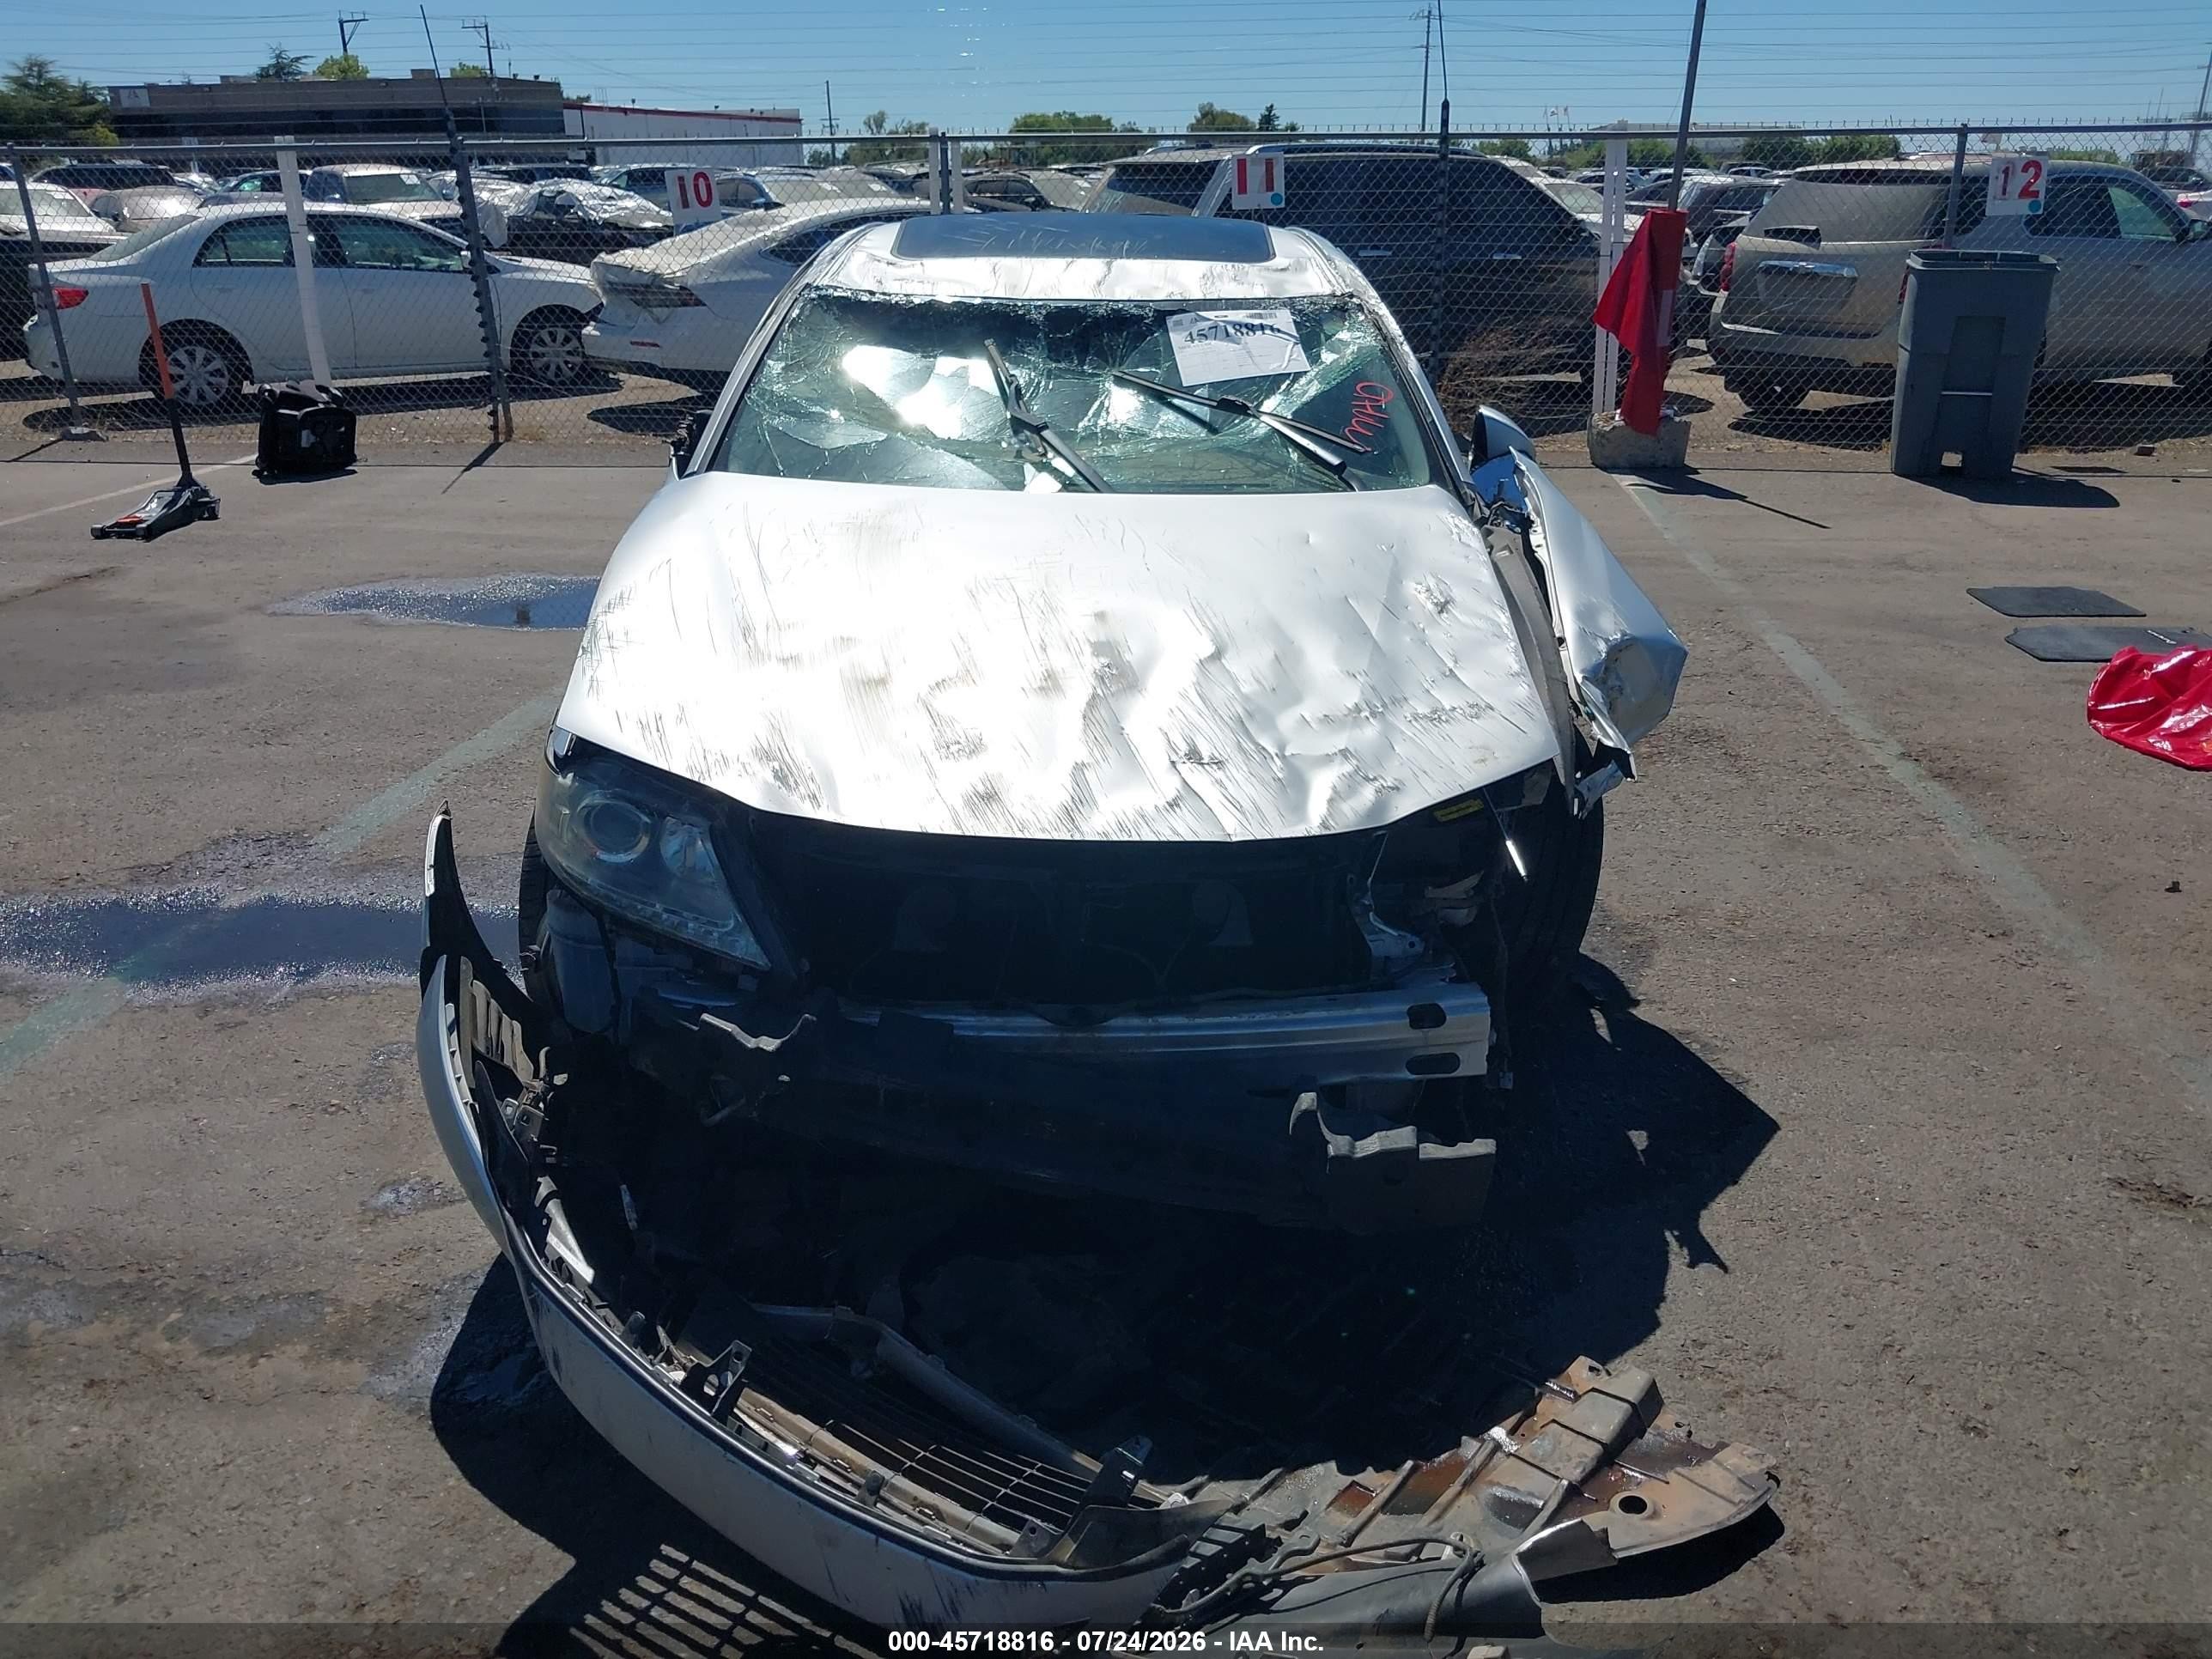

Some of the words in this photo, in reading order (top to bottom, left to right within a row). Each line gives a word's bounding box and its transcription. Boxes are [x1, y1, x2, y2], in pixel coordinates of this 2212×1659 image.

[677, 171, 713, 209] 10
[1237, 158, 1275, 195] 11
[2002, 160, 2042, 199] 12
[1184, 323, 1280, 343] 45718816
